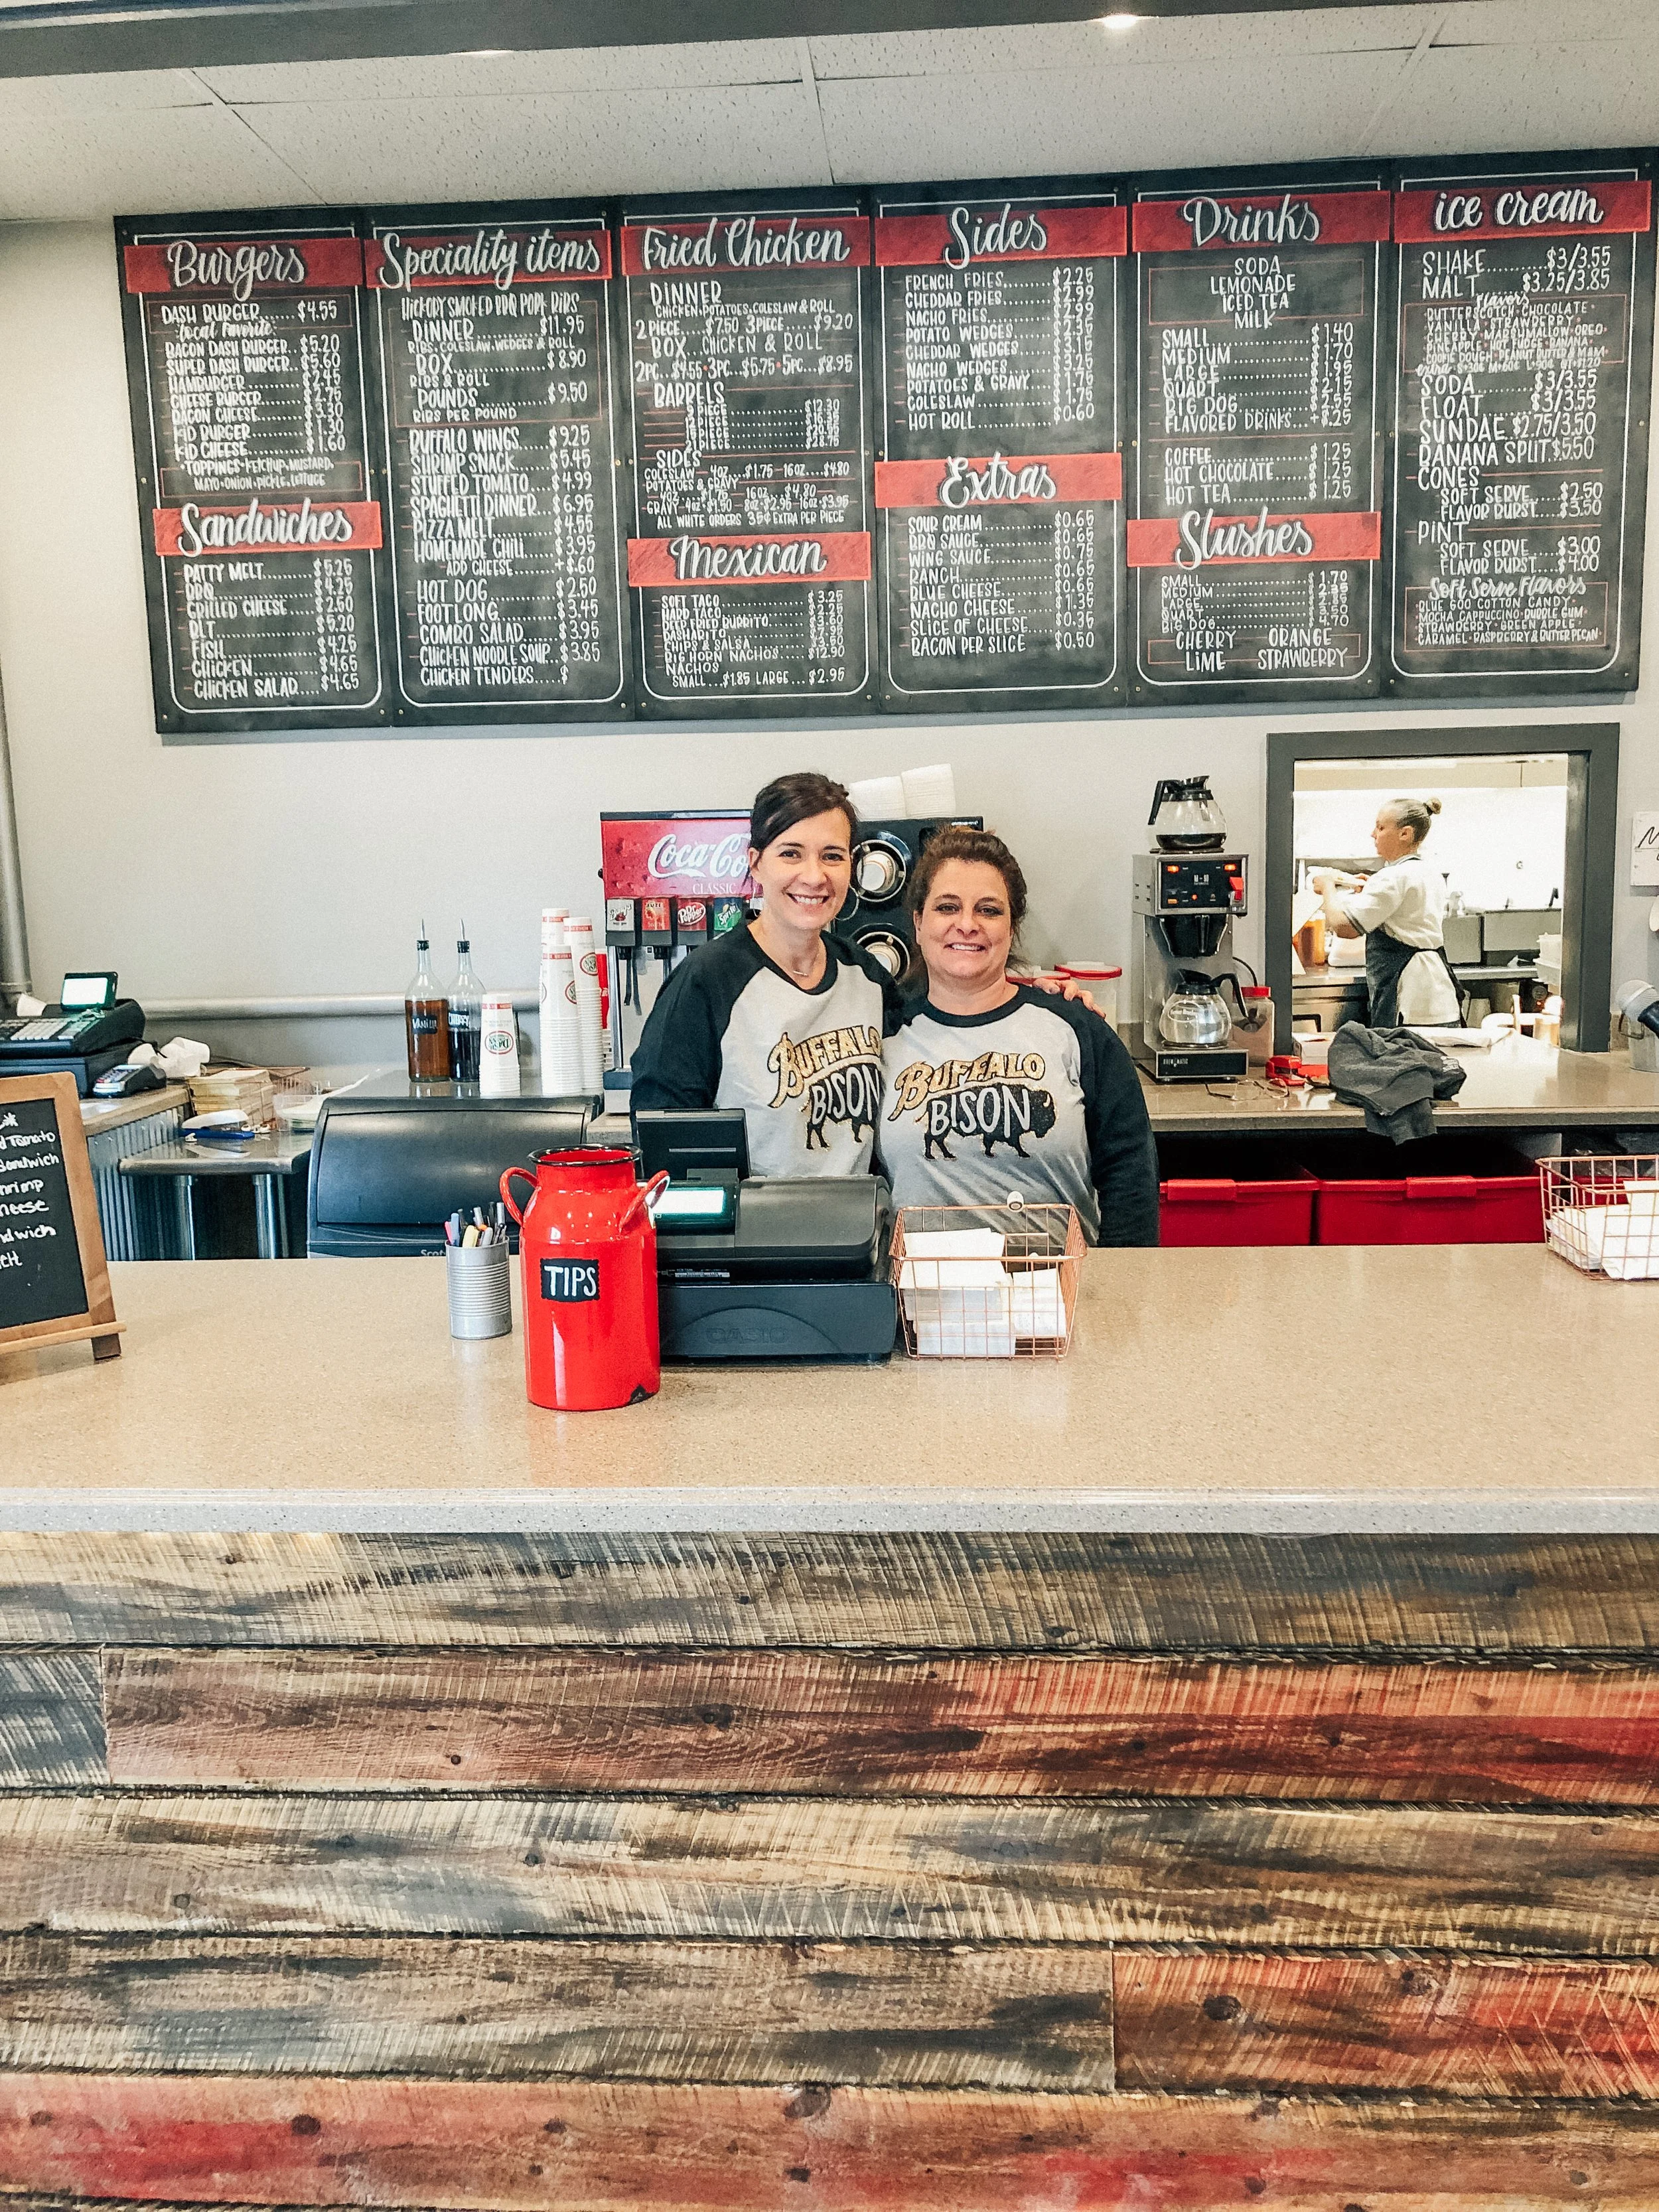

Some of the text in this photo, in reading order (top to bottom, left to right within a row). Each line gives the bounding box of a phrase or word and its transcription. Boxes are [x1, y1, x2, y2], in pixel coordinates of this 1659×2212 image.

[1435, 188, 1604, 230] ice cream
[1183, 194, 1320, 247] Drinks
[643, 216, 849, 270] Fried Chicken
[944, 203, 1047, 270] Sides
[379, 228, 600, 292] Speciality items
[1234, 256, 1281, 275] SODA
[1423, 242, 1611, 275] SHAKE $3/3.55
[167, 240, 305, 301] Burgers
[905, 273, 953, 291] FRENCH
[1210, 274, 1295, 295] LEMONADE
[1422, 268, 1611, 299] MALT $3.25/3.85
[447, 293, 546, 318] SMOKED BBQ PORK
[905, 291, 961, 309] CHEDDAR
[1222, 293, 1289, 313] ICED TEA
[162, 301, 337, 324] DASH BURGER $4.55
[906, 310, 946, 327] NACHO
[1234, 311, 1276, 329] MILK
[906, 323, 1013, 342] POTATO WEDGES
[1162, 328, 1210, 349] SMALL
[165, 338, 288, 359] BACON DASH BURGER
[651, 332, 823, 359] BOX & ROLL
[1161, 346, 1230, 365] MEDIUM
[415, 353, 453, 376] BOX
[1163, 365, 1219, 382] LARGE
[169, 375, 245, 394] HAMBURGER
[458, 372, 490, 387] ROLL
[907, 373, 1030, 395] POTATOES & GRAVY
[1163, 380, 1219, 398] QUART
[1421, 373, 1475, 396] SODA
[171, 391, 261, 409] CHEESE BURGER
[417, 387, 478, 410] POUNDS
[654, 382, 725, 408] BARRELS
[907, 394, 975, 411] COLESLAW
[172, 406, 257, 425] BACON CHEESE
[447, 407, 517, 421] PER POUND
[1166, 396, 1238, 417] BIG DOG
[1421, 395, 1483, 417] FLOAT
[908, 411, 975, 431] HOT ROLL
[1419, 417, 1506, 444] SUNDAE
[409, 428, 467, 455] BUFFALO
[469, 452, 516, 473] SNACK
[656, 449, 702, 469] SIDES
[1165, 447, 1211, 466] COFFEE
[1419, 439, 1550, 467] BANANA SPLIT
[644, 467, 695, 480] COLESLAW
[941, 451, 1056, 508] Extras
[1165, 463, 1274, 484] HOT CHOCOLATE
[1418, 465, 1480, 490] CONES
[410, 473, 528, 496] STUFFED TOMATO
[646, 477, 739, 493] POTATOES GRAVY
[1166, 484, 1230, 505] HOT TEA
[179, 497, 353, 557] Sandwiches
[413, 516, 494, 540] PIZZA MELT
[657, 512, 741, 529] ALL WHITE ORDERS
[908, 514, 982, 535] SOUR CREAM
[908, 533, 979, 551] BBQ SAUCE
[1175, 506, 1313, 570] Slushes
[413, 538, 486, 563] HOMEMADE
[670, 535, 828, 580] Mexican
[950, 549, 991, 565] SAUCE
[184, 562, 264, 583] PATTY MELT
[447, 560, 513, 576] ADD CHEESE
[910, 567, 960, 585] RANCH
[185, 583, 214, 601] BBQ
[417, 577, 488, 603] HOT DOG
[910, 582, 1001, 602] BLUE CHEESE
[242, 599, 288, 617] CHEESE
[662, 595, 719, 609] SOFT TACO
[910, 599, 1015, 619] NACHO CHEESE
[662, 607, 721, 621] HARD TACO
[188, 620, 215, 639] BLT
[419, 623, 524, 645] COMBO SALAD
[1176, 628, 1332, 649] CHERRY ORANGE
[472, 643, 550, 666] NOODLE SOUP
[715, 638, 750, 650] SALSA
[911, 634, 1026, 656] BACON PER SLICE
[689, 649, 778, 662] HORN NACHOS
[1186, 647, 1348, 672] LIME STRAWBERRY
[474, 665, 534, 686] TENDERS
[666, 661, 719, 676] NACHOS
[254, 677, 299, 698] SALAD
[672, 671, 788, 688] SMALL LARGE
[648, 833, 752, 878] Coca-Co
[693, 883, 736, 895] CLASSIC
[678, 906, 704, 922] Pepper
[719, 903, 740, 925] Sprite
[768, 1025, 880, 1109] BUFFALO
[812, 1063, 880, 1126] BISON
[887, 1052, 1045, 1121] BUFFALO
[930, 1085, 1031, 1138] BISON
[544, 1266, 597, 1297] TIPS
